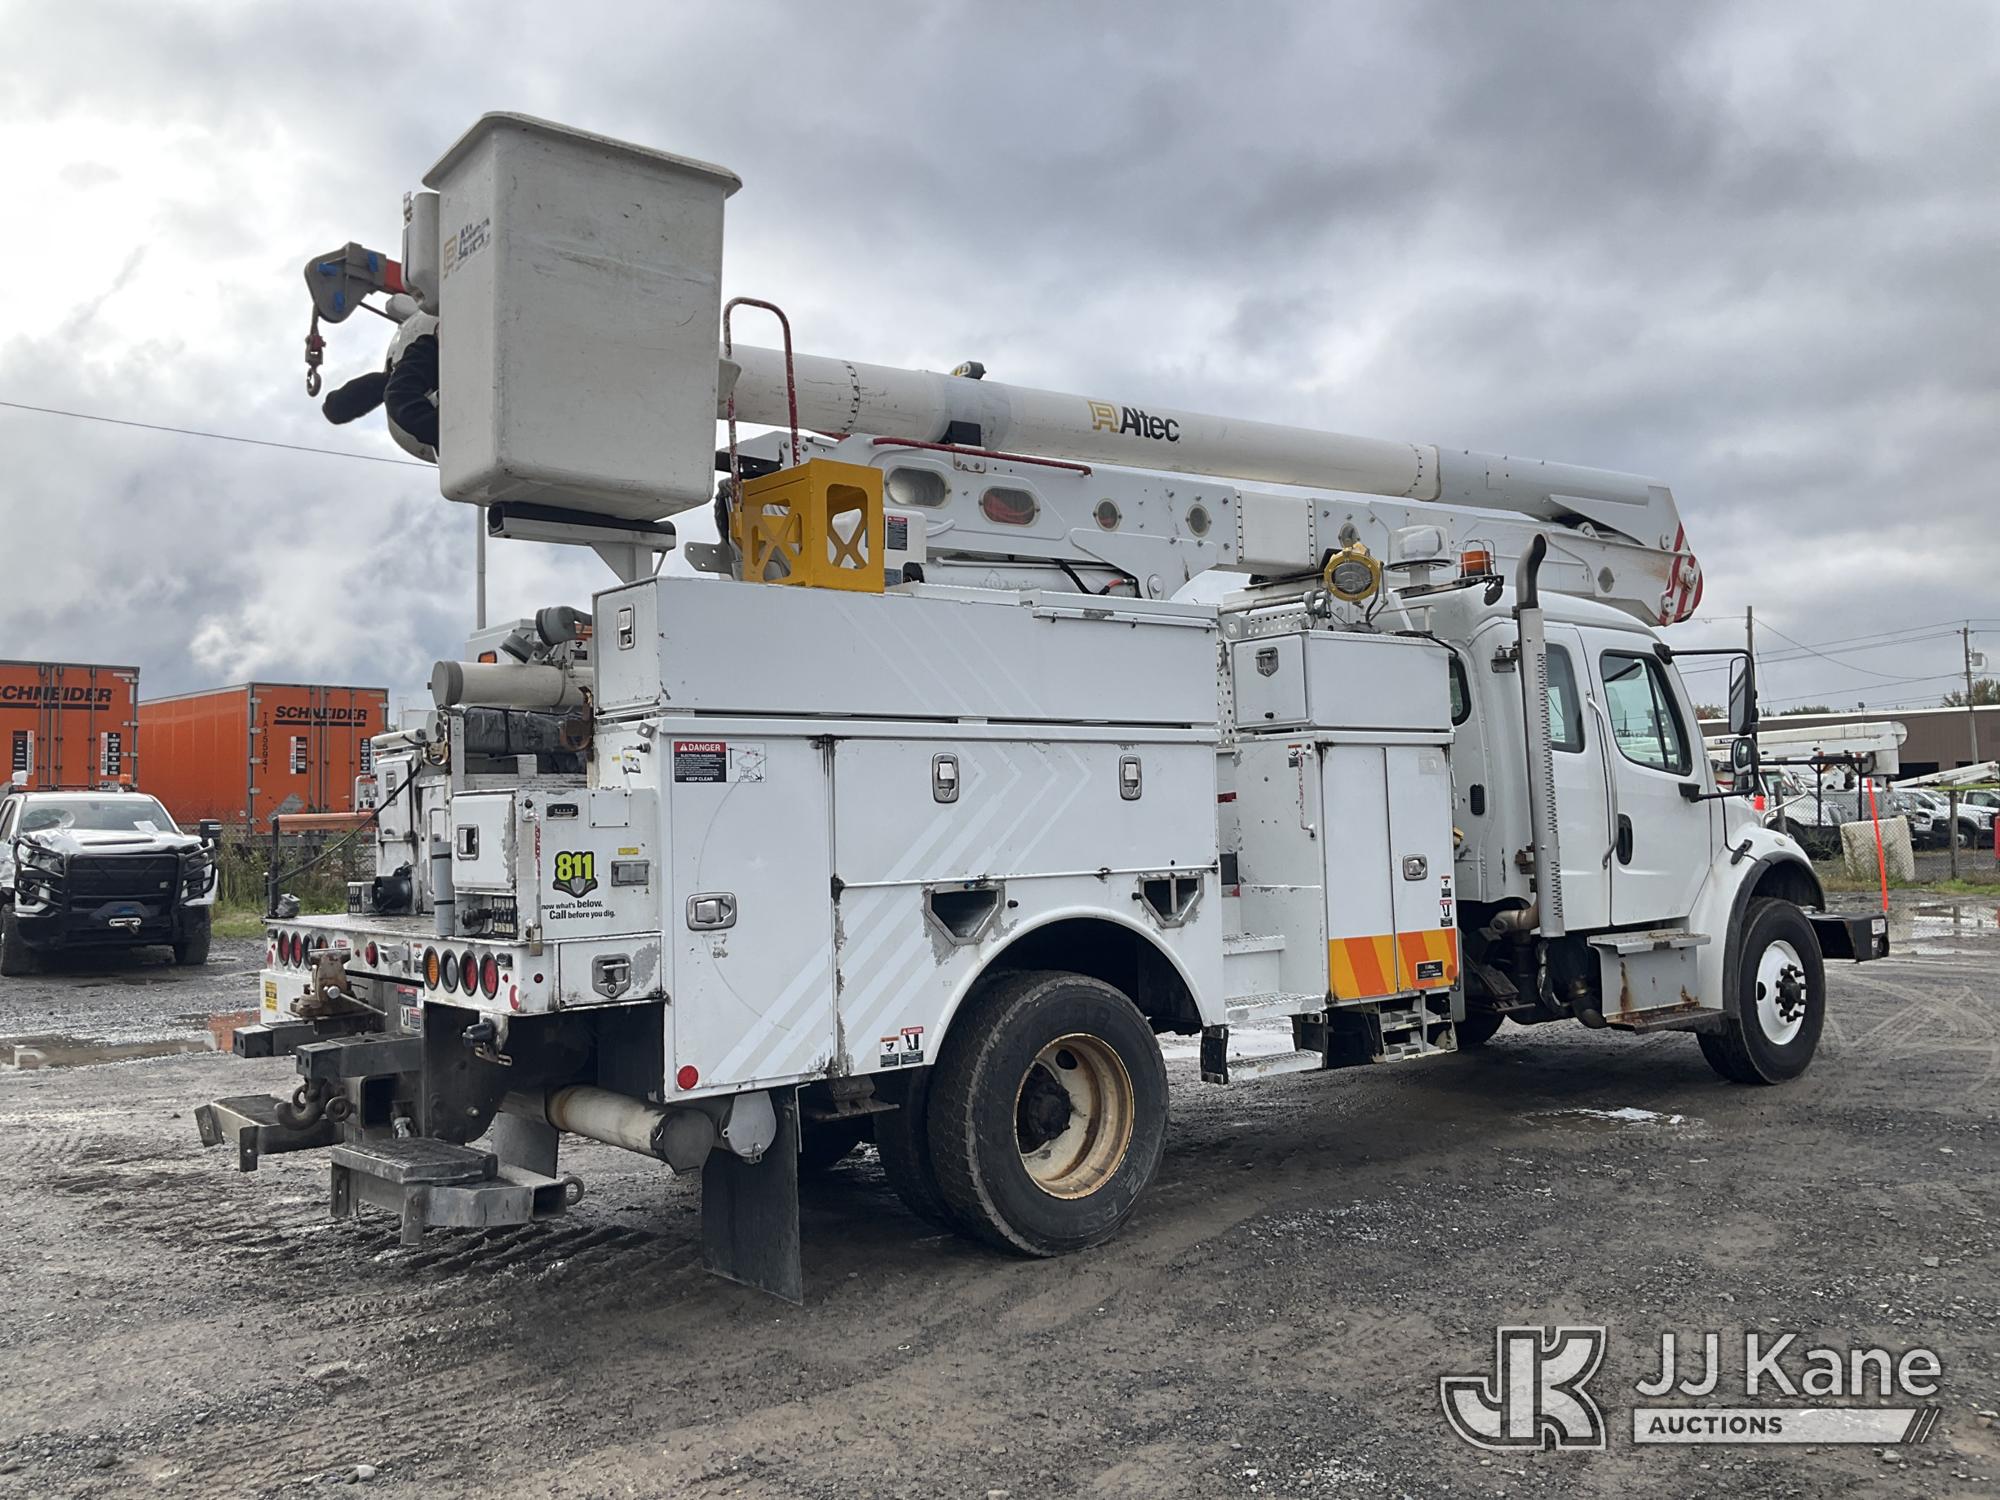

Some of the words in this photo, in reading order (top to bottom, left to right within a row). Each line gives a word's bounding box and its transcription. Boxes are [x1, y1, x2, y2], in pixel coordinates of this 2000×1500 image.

[1120, 406, 1179, 441] Altec
[0, 686, 112, 702] CHNEIDER
[275, 706, 368, 720] SCHNEIDER
[688, 743, 721, 751] DANGER
[554, 851, 594, 881] 811
[577, 899, 603, 908] below.
[549, 910, 567, 920] Call
[568, 911, 590, 919] before
[590, 911, 602, 919] you
[603, 910, 616, 918] dig.
